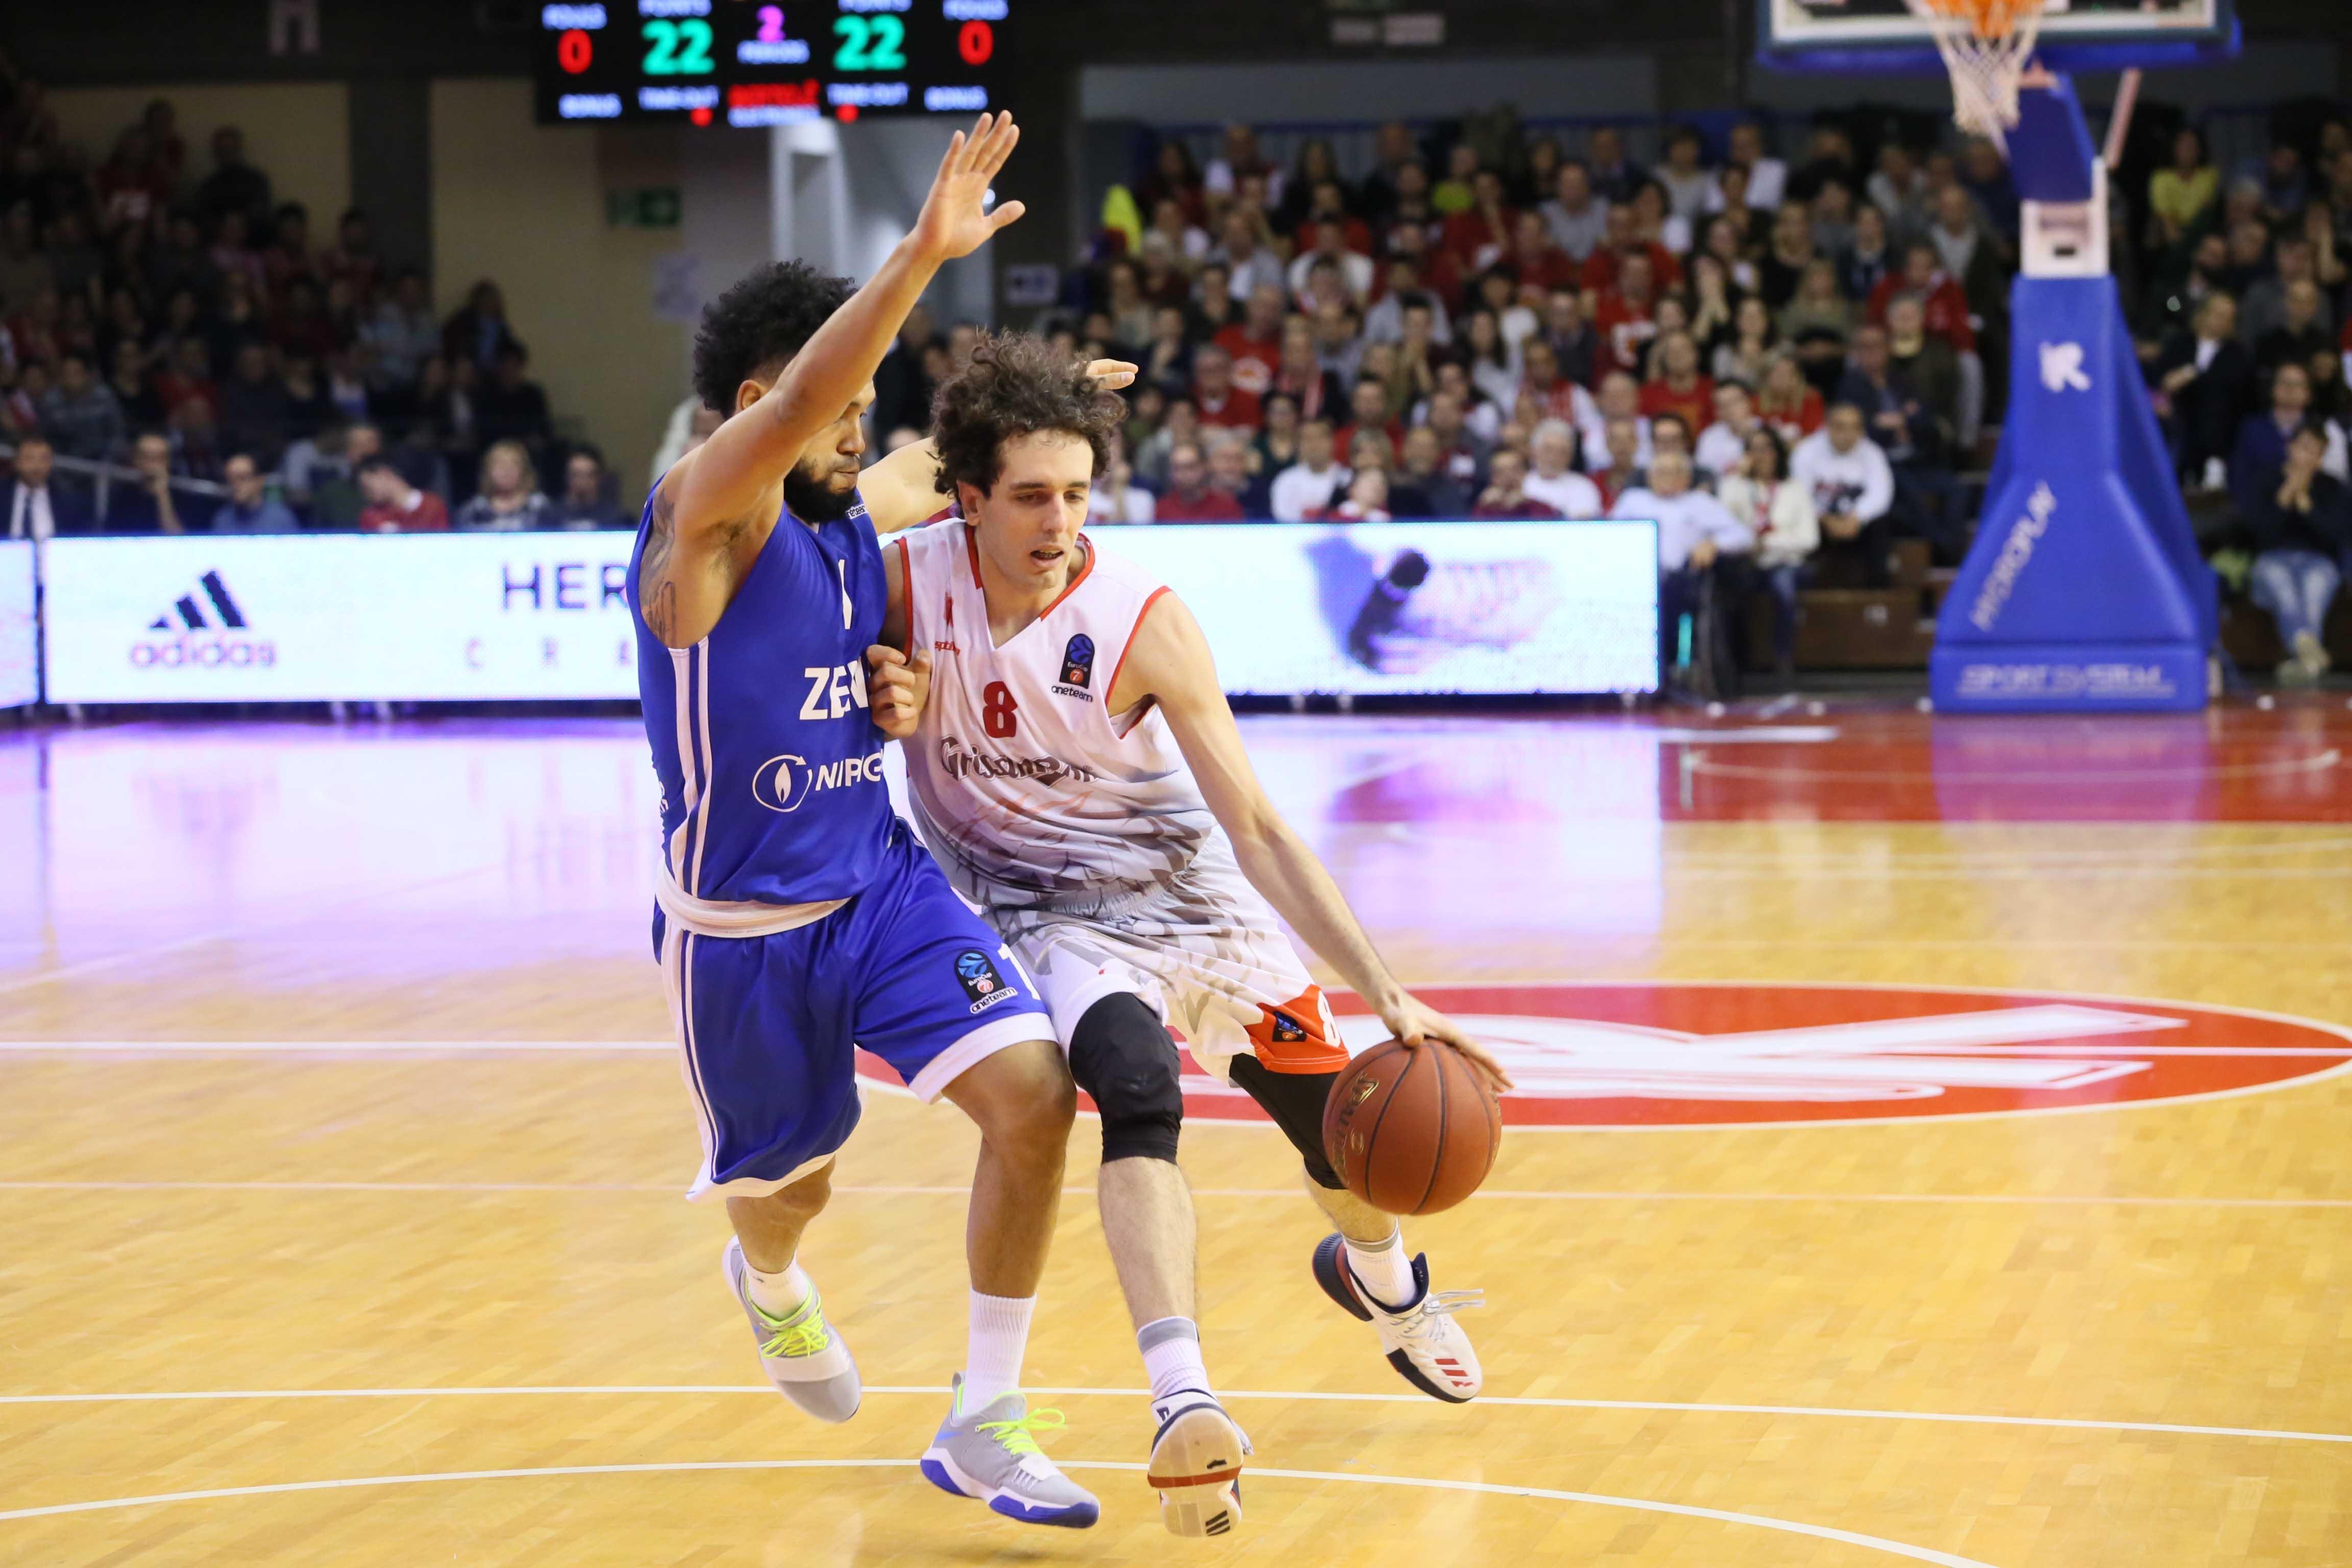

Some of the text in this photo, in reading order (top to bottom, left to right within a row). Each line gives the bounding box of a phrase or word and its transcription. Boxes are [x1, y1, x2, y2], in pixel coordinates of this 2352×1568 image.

[557, 29, 593, 74] 0
[641, 19, 715, 75] 22
[832, 14, 907, 71] 22
[958, 19, 994, 65] 0
[983, 681, 1018, 738] 8
[1051, 685, 1093, 702] oneteam
[972, 988, 1016, 1013] oneteam
[1317, 990, 1341, 1047] 8
